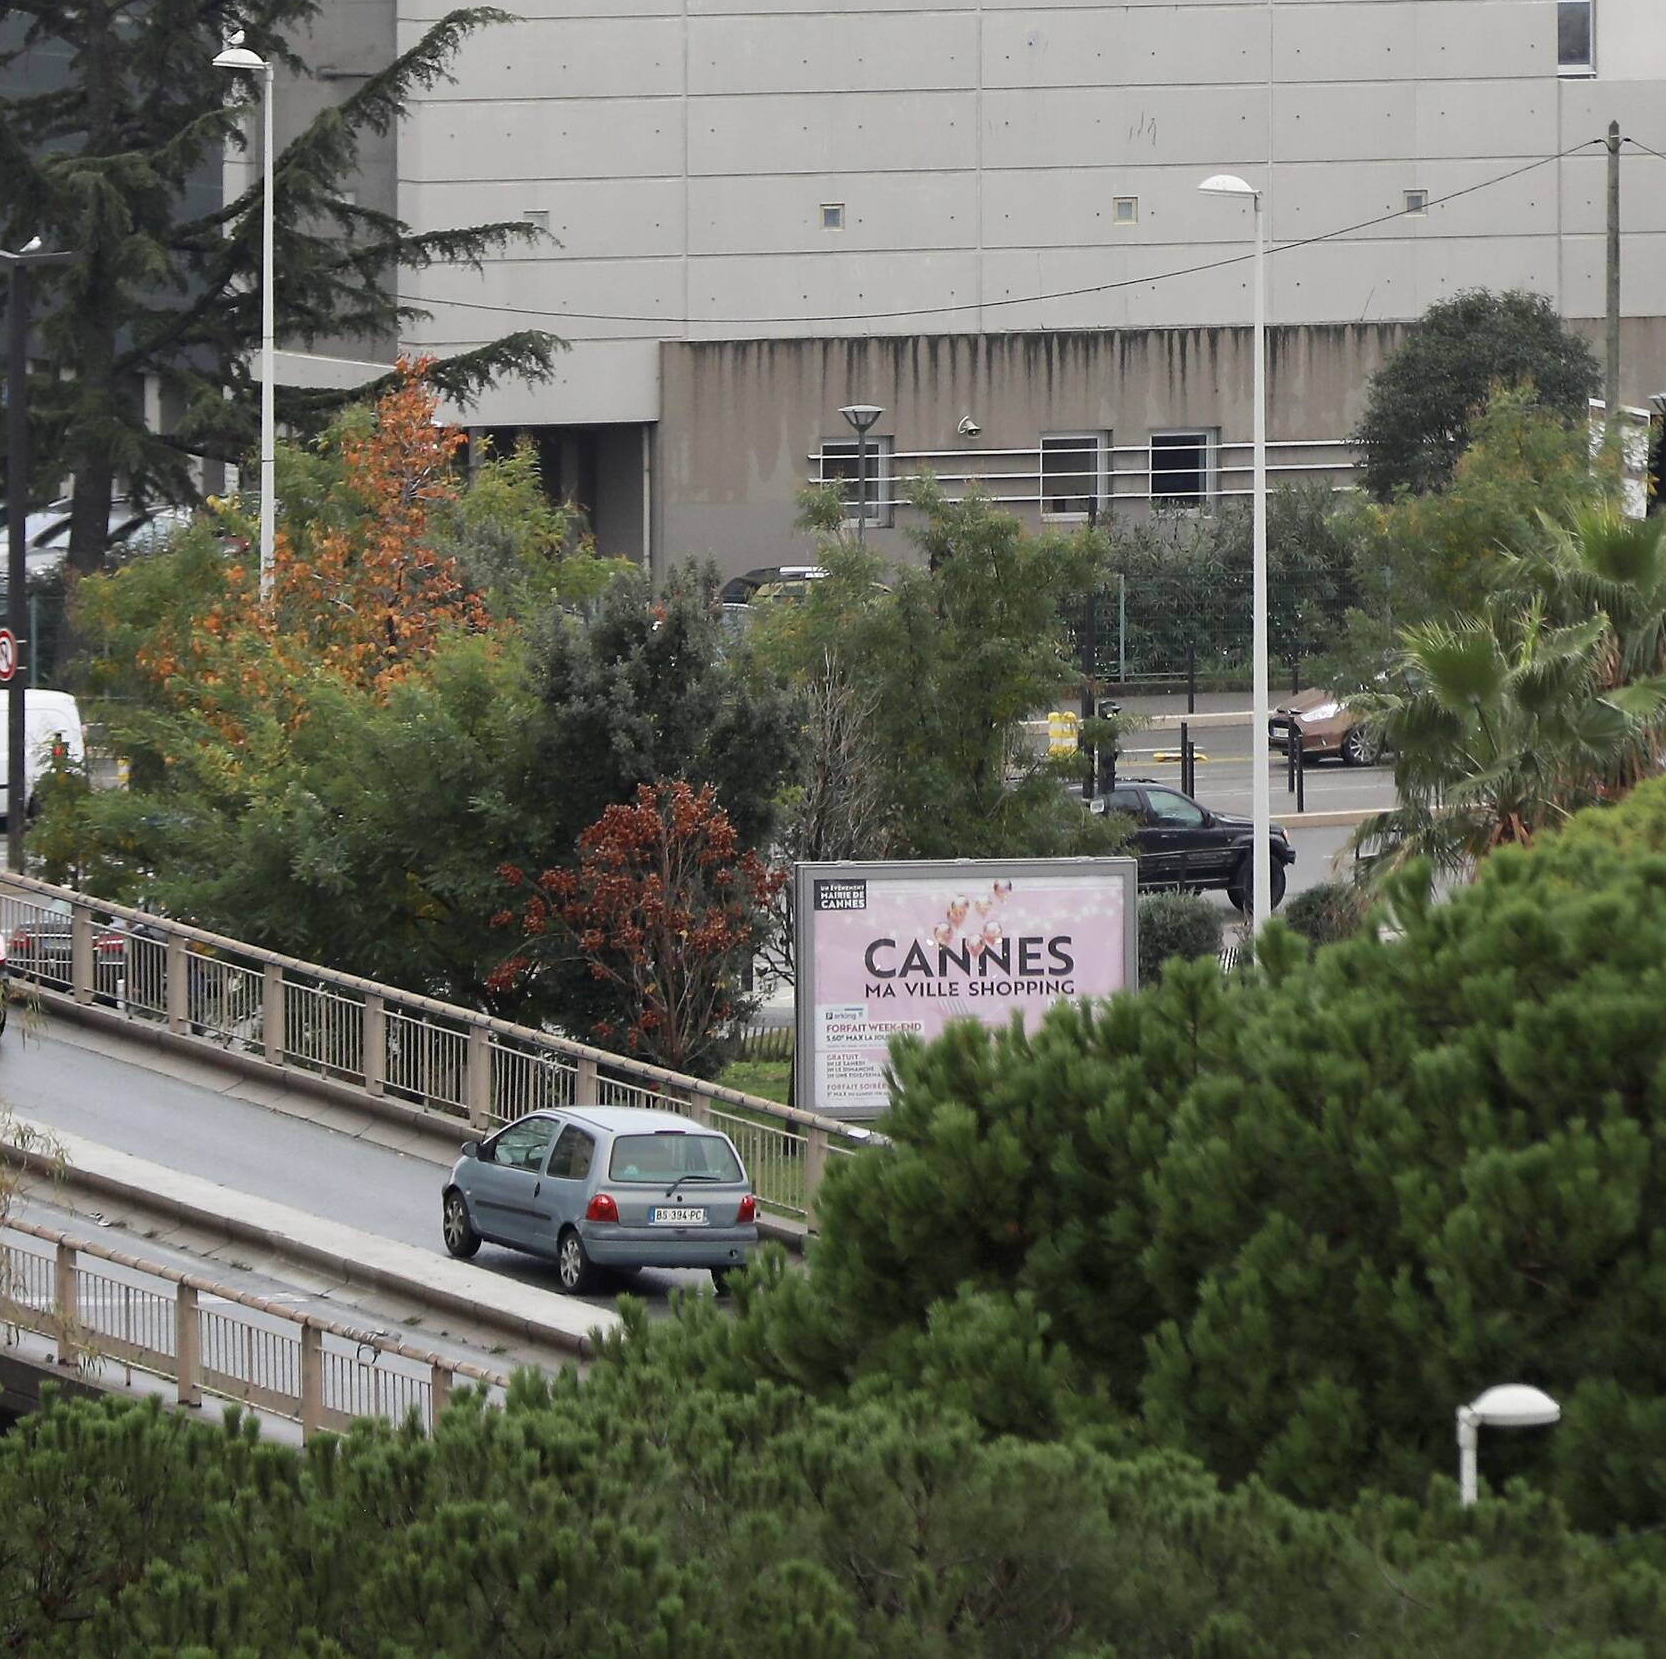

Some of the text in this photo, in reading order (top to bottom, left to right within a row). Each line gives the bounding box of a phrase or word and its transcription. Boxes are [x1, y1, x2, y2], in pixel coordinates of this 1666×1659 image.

[820, 891, 864, 899] MAIRIE DE
[821, 899, 865, 909] CANNES
[864, 935, 1075, 978] CANNES
[865, 980, 1075, 998] MA VILLE SHOPPING
[826, 1022, 921, 1033] FORFAIT WEEK-END
